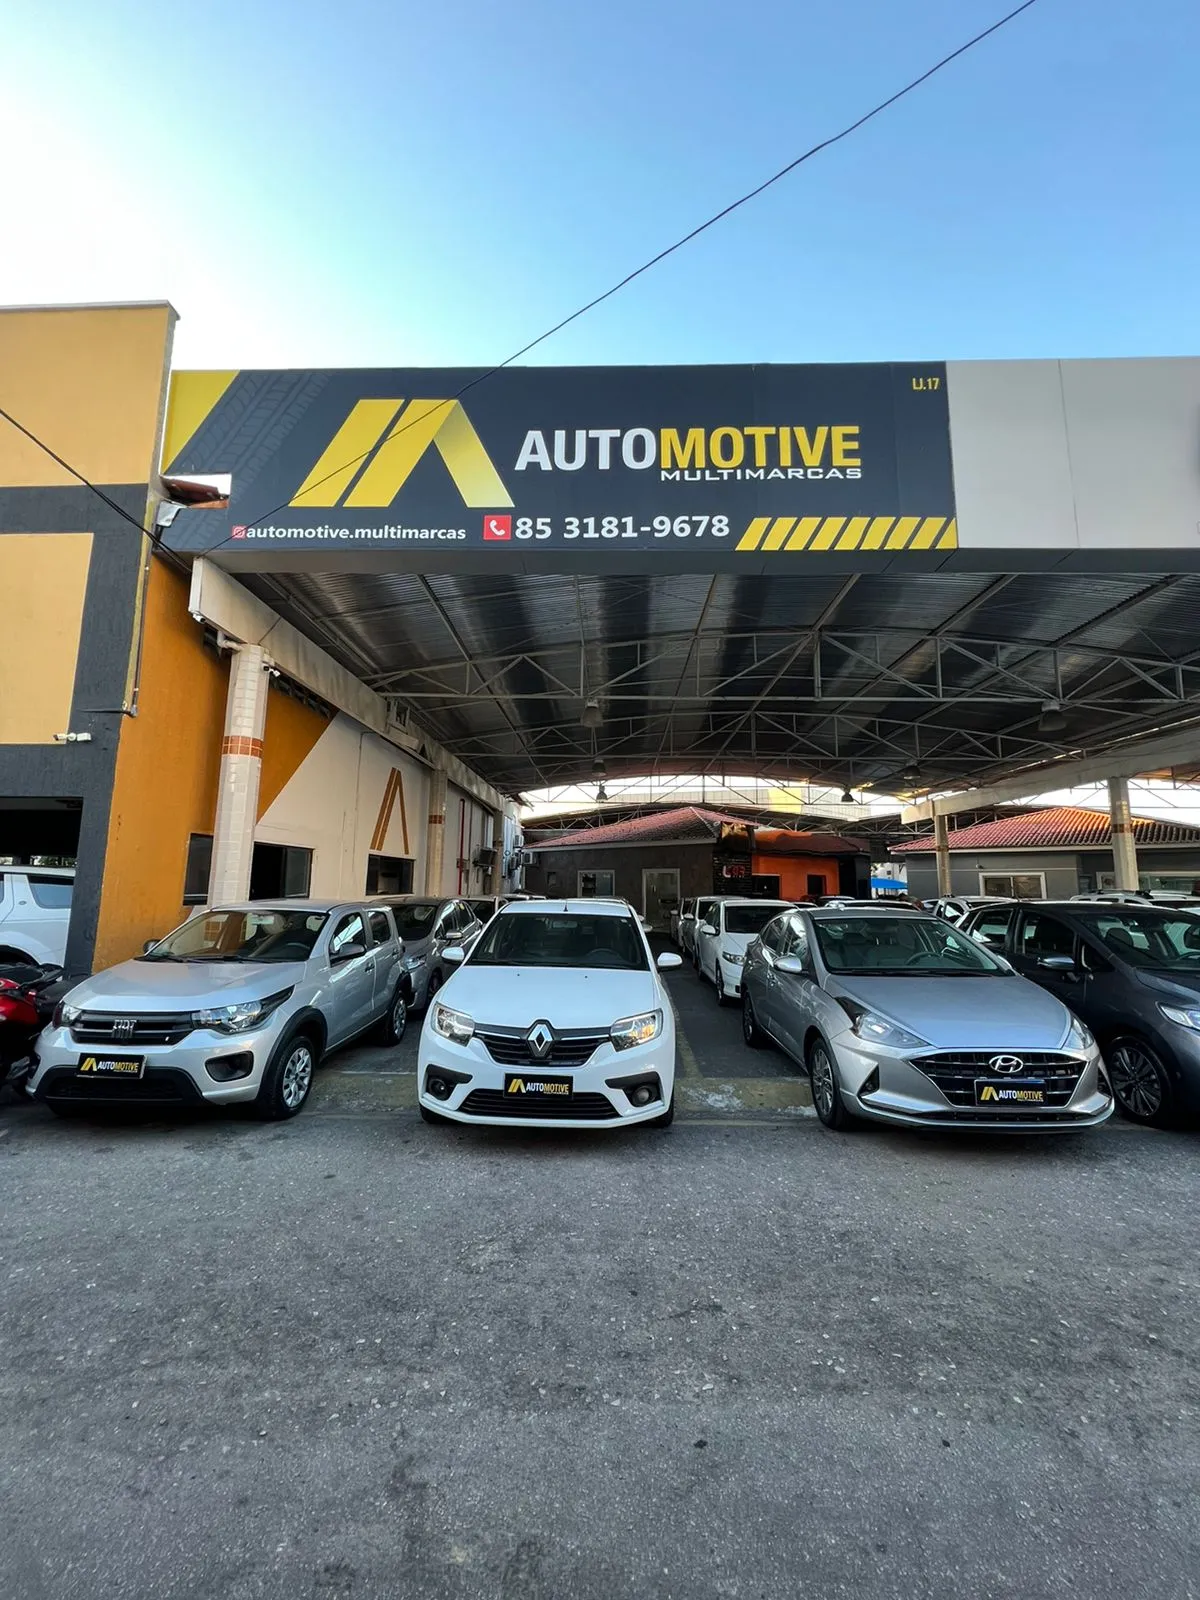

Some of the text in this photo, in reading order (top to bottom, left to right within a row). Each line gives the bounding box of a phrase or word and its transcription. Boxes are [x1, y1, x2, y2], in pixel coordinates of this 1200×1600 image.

[514, 426, 861, 470] AUTOMOTIVE
[660, 468, 862, 481] MULTIMARCAS
[247, 525, 466, 539] automotive.multimarcas
[515, 515, 730, 539] 85 3181-9678
[97, 1060, 139, 1071] AUTOMOTIVE
[526, 1082, 569, 1092] AUTOMOTIVE
[999, 1089, 1043, 1099] AUTOMOTIVE
